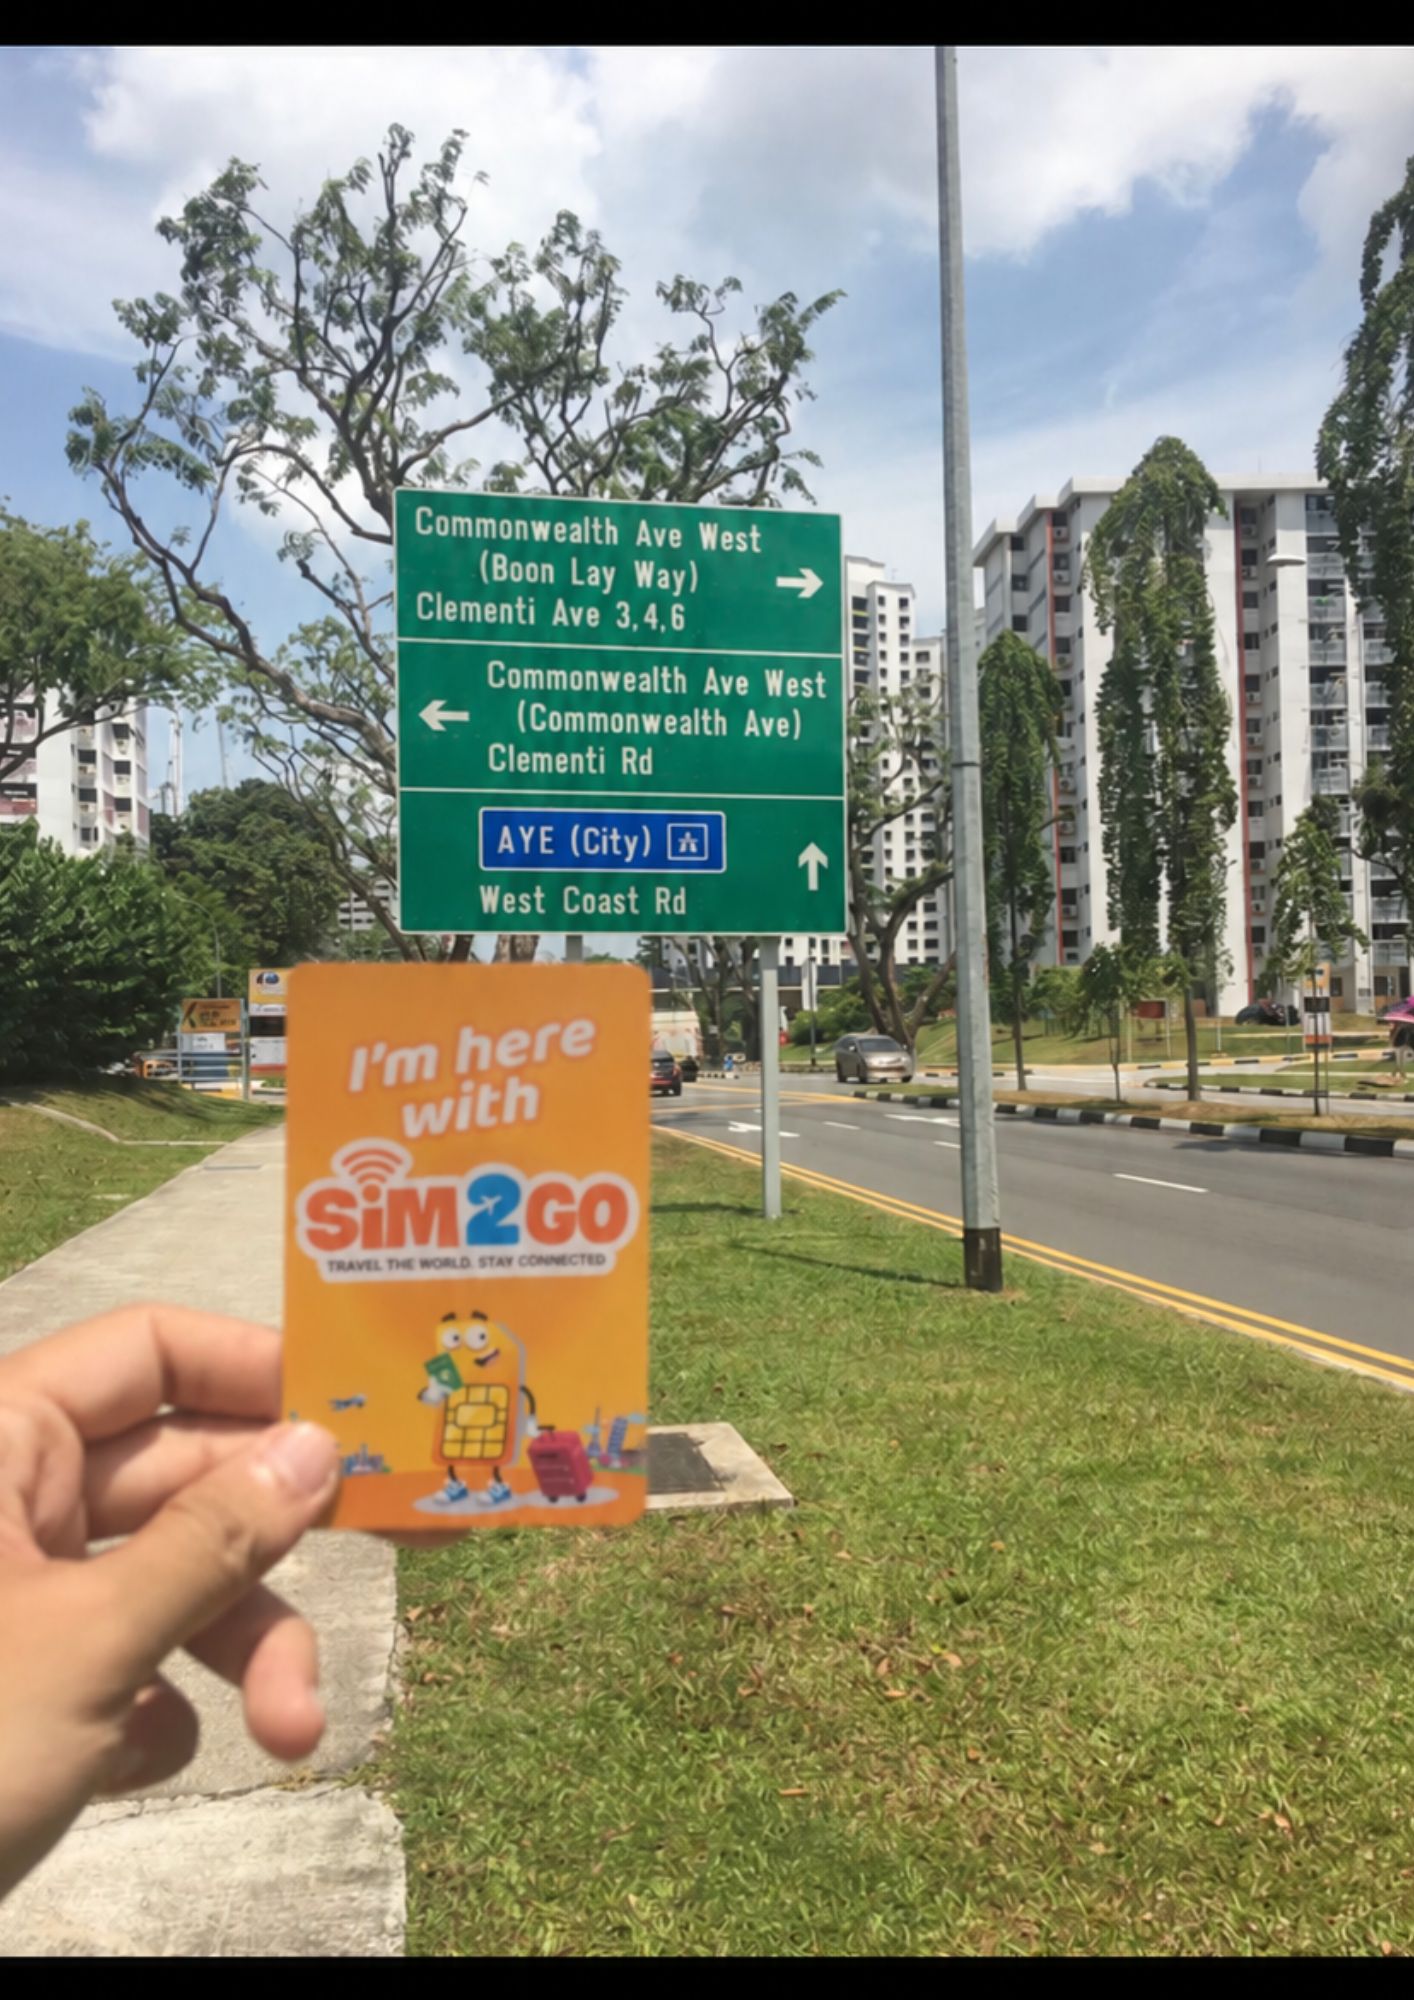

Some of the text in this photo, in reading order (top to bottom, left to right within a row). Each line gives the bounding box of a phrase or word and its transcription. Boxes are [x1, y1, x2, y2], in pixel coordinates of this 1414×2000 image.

[415, 506, 762, 553] Commonwealth Ave West
[480, 549, 699, 596] (Boon Lay Way)
[417, 592, 686, 632] Clementi Ave 3,4,6
[487, 660, 826, 699] Commonwealth Ave West
[517, 700, 801, 739] (Commonwealth Ave)
[488, 743, 653, 775] Clementi Rd
[497, 825, 651, 863] AYE (City)
[480, 885, 686, 915] West Coast Rd
[348, 1018, 596, 1093] I'm here
[402, 1076, 540, 1139] with
[327, 1259, 382, 1272] TRAVEL
[387, 1258, 414, 1270] THE
[478, 1255, 514, 1268] STAY
[518, 1253, 606, 1267] CONNECTED
